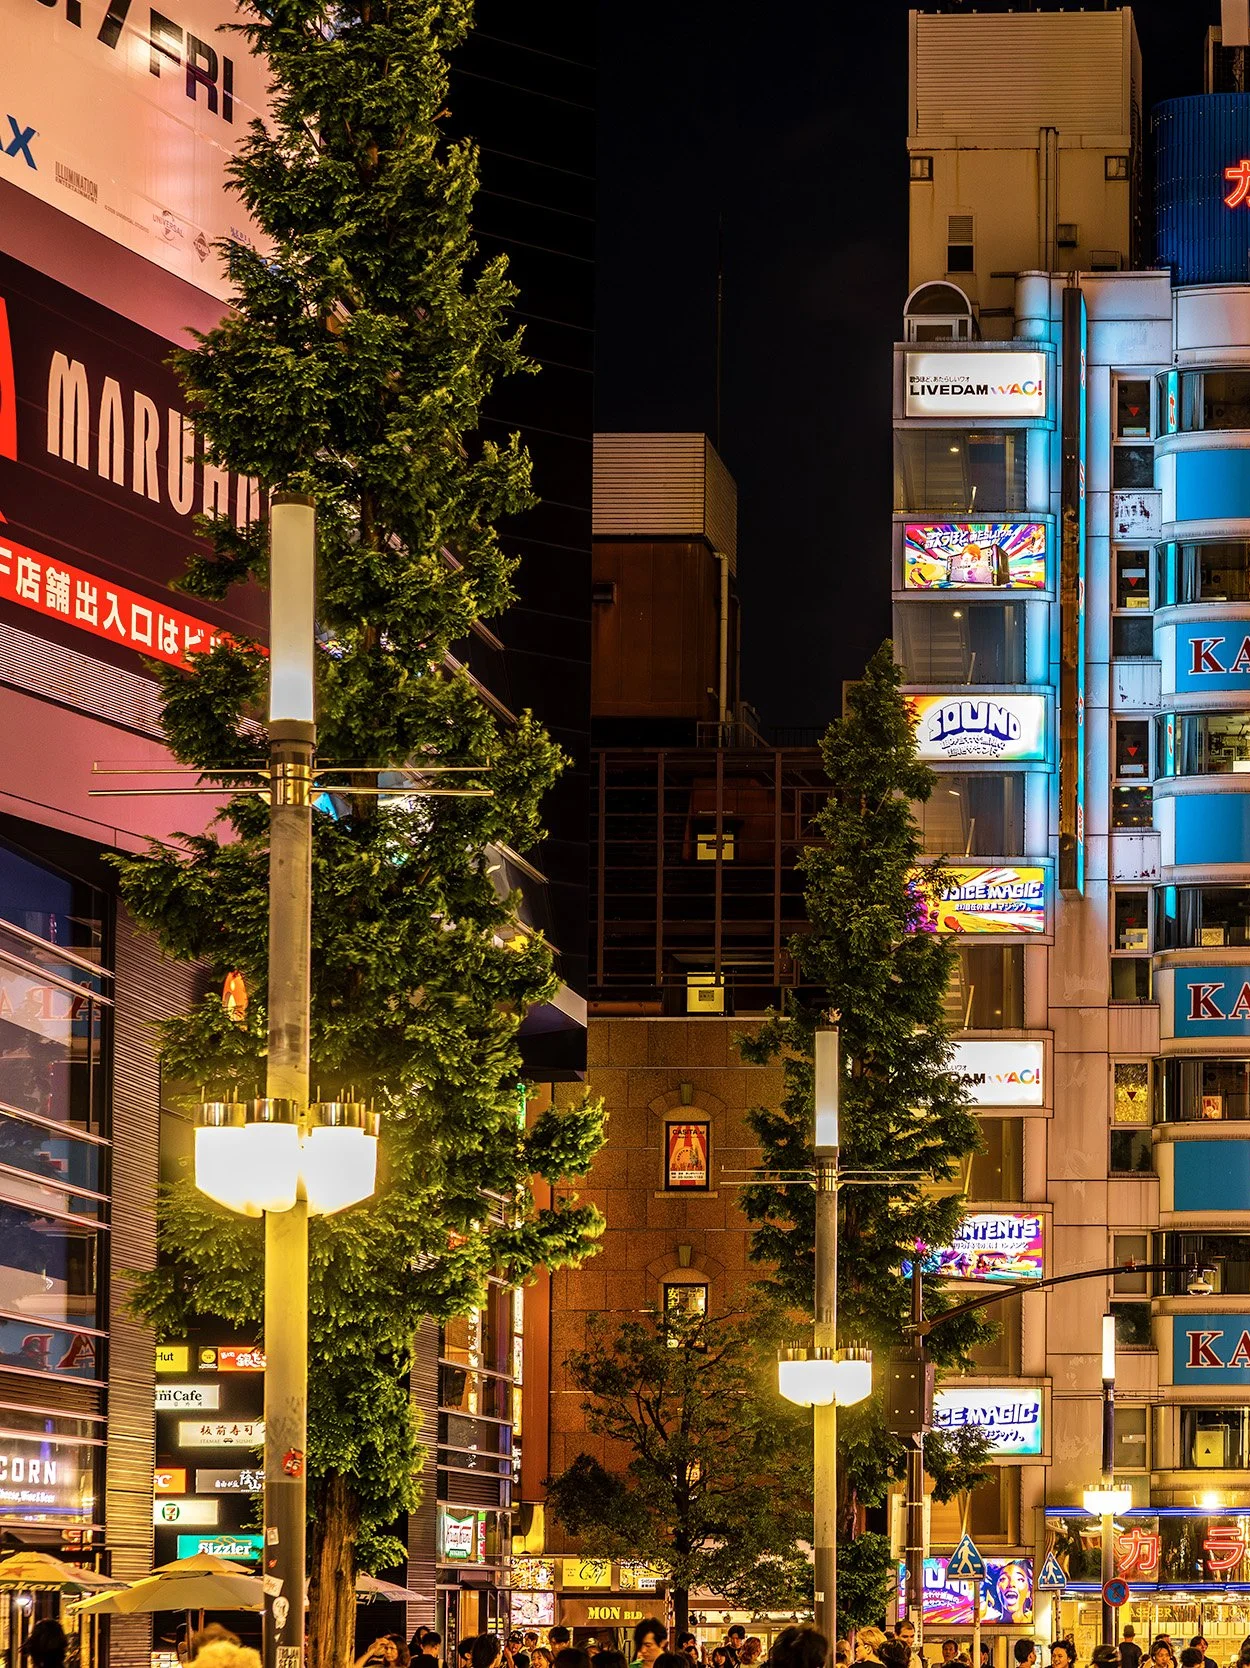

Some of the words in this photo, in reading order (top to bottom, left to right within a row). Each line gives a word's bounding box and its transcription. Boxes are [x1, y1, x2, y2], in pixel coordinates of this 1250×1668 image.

[149, 7, 234, 125] FRI
[55, 161, 98, 198] ILLUMINATION
[152, 213, 184, 238] UNIVERSAL
[910, 384, 988, 396] LIVEDAM
[927, 701, 1021, 742] SOUND
[988, 882, 1044, 899] MAGIC
[967, 1402, 1039, 1426] MAGIC
[200, 1424, 253, 1436] 板前寿司
[198, 1540, 253, 1556] Sizzler
[588, 1606, 621, 1620] MON
[624, 1611, 645, 1619] BLD.
